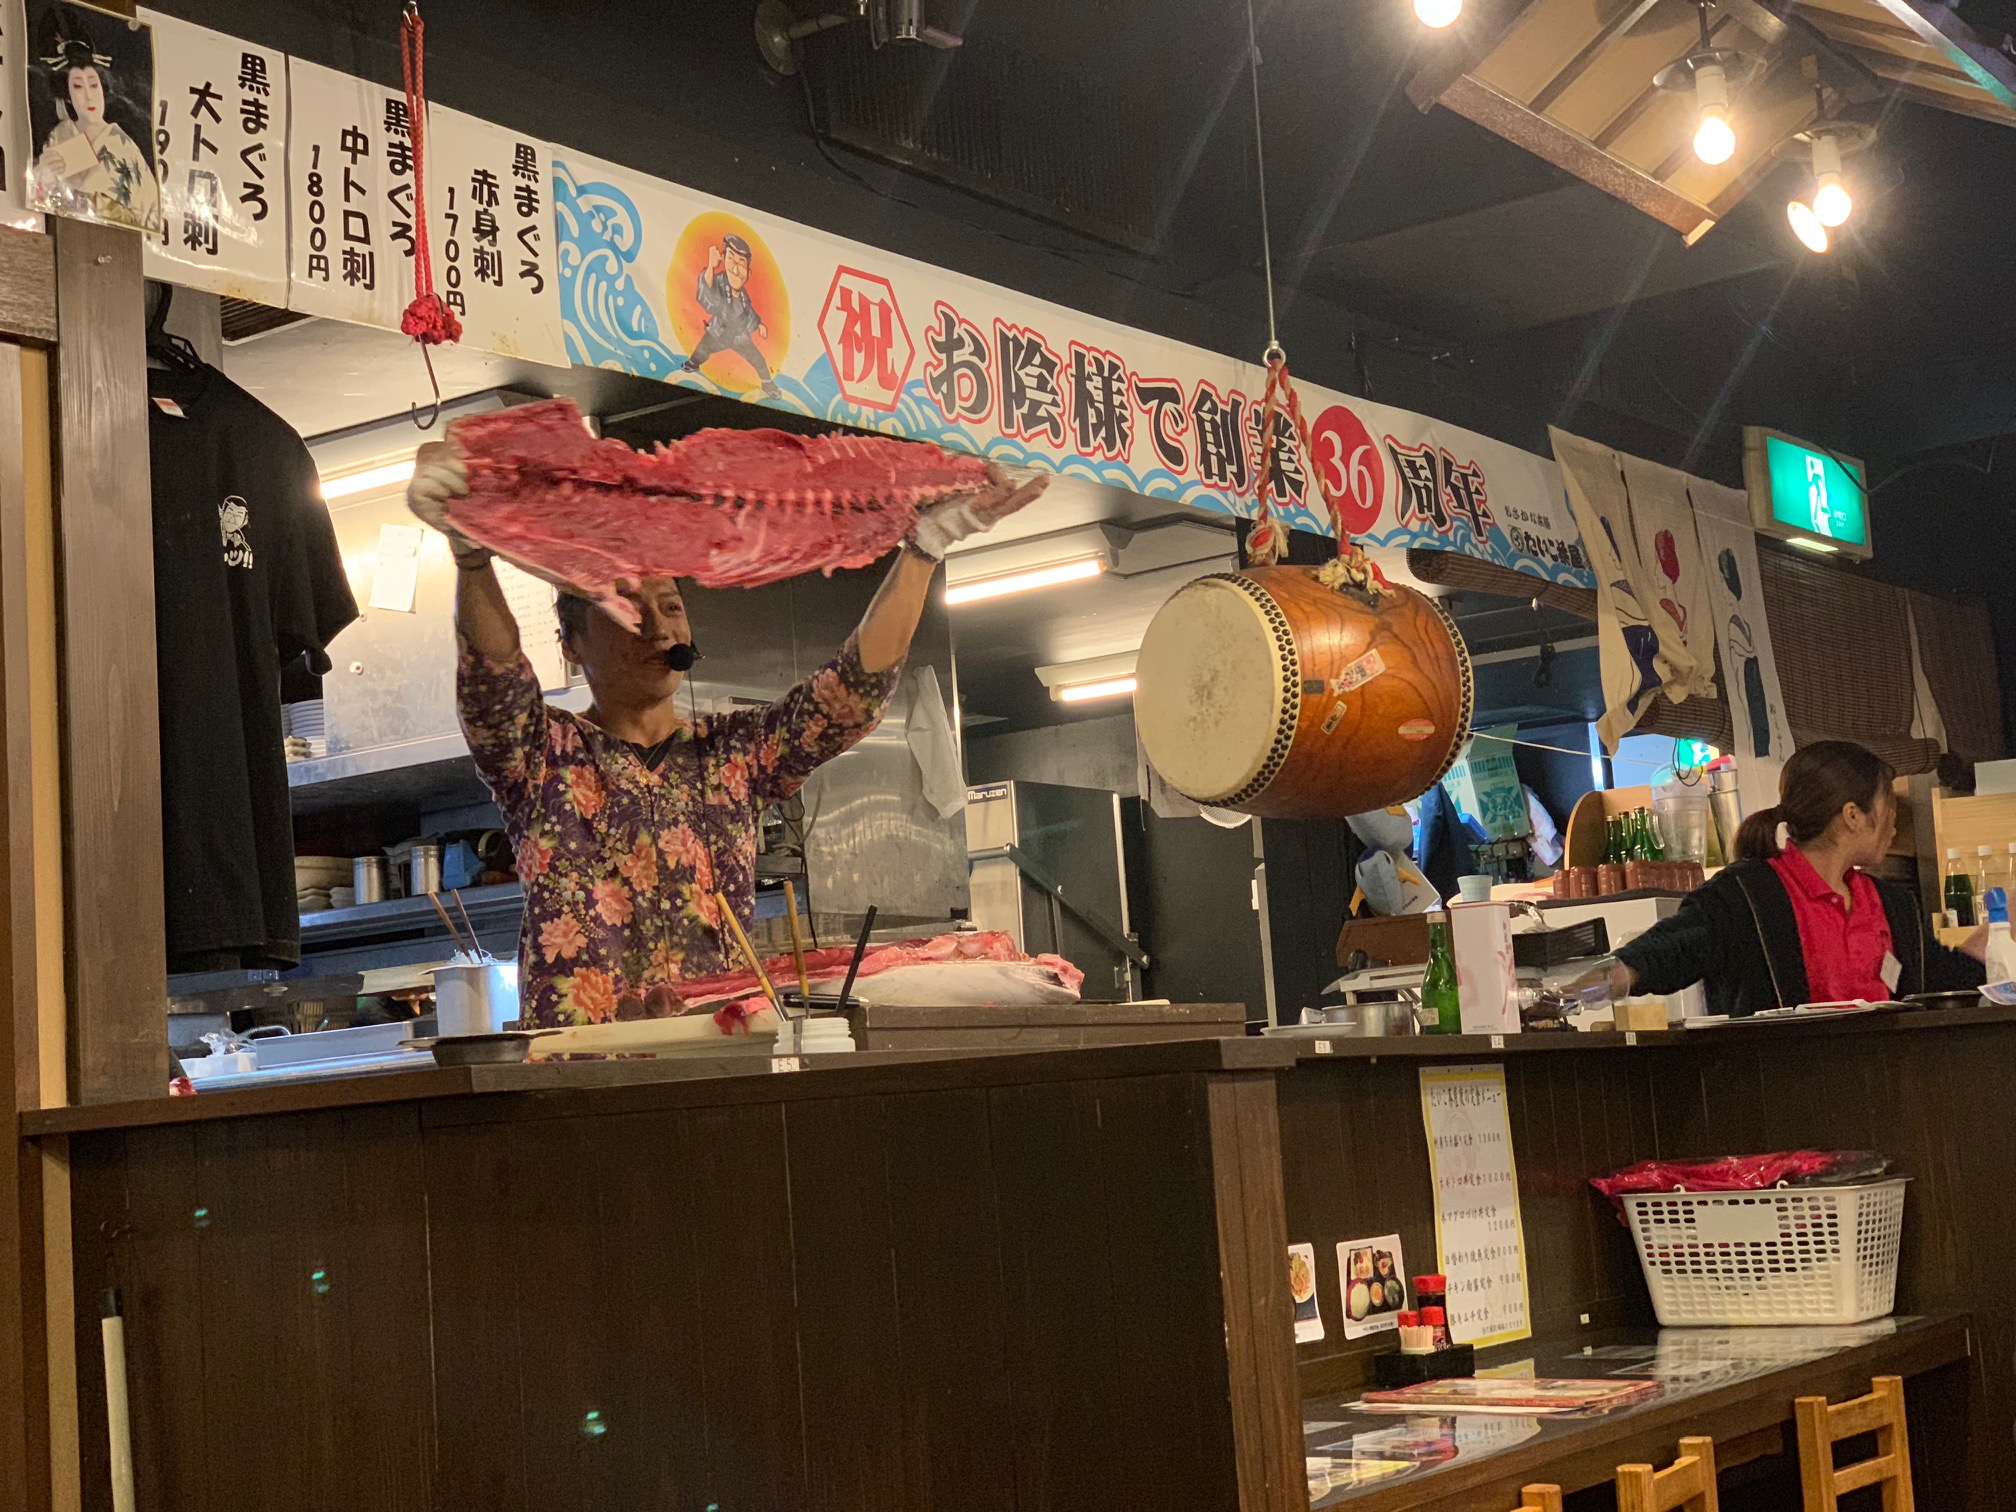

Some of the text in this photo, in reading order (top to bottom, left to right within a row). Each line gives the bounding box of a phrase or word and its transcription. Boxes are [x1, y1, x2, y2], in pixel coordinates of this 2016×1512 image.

[183, 81, 223, 256] 大トロ刺
[238, 52, 271, 221] 黒まぐろ
[383, 98, 416, 258] 黒まぐろ
[307, 145, 330, 283] 1800円
[340, 125, 375, 291] 中トロ刺
[444, 186, 466, 317] 1700円
[470, 168, 504, 287] 赤身刺
[512, 143, 545, 295] 黒まぐろ
[837, 287, 897, 386] 祝
[967, 788, 1007, 801] Maruzen
[778, 1058, 793, 1072] E5
[1487, 1219, 1515, 1231] 1200円
[1500, 1272, 1521, 1285] 900円
[1503, 1302, 1524, 1316] 900円
